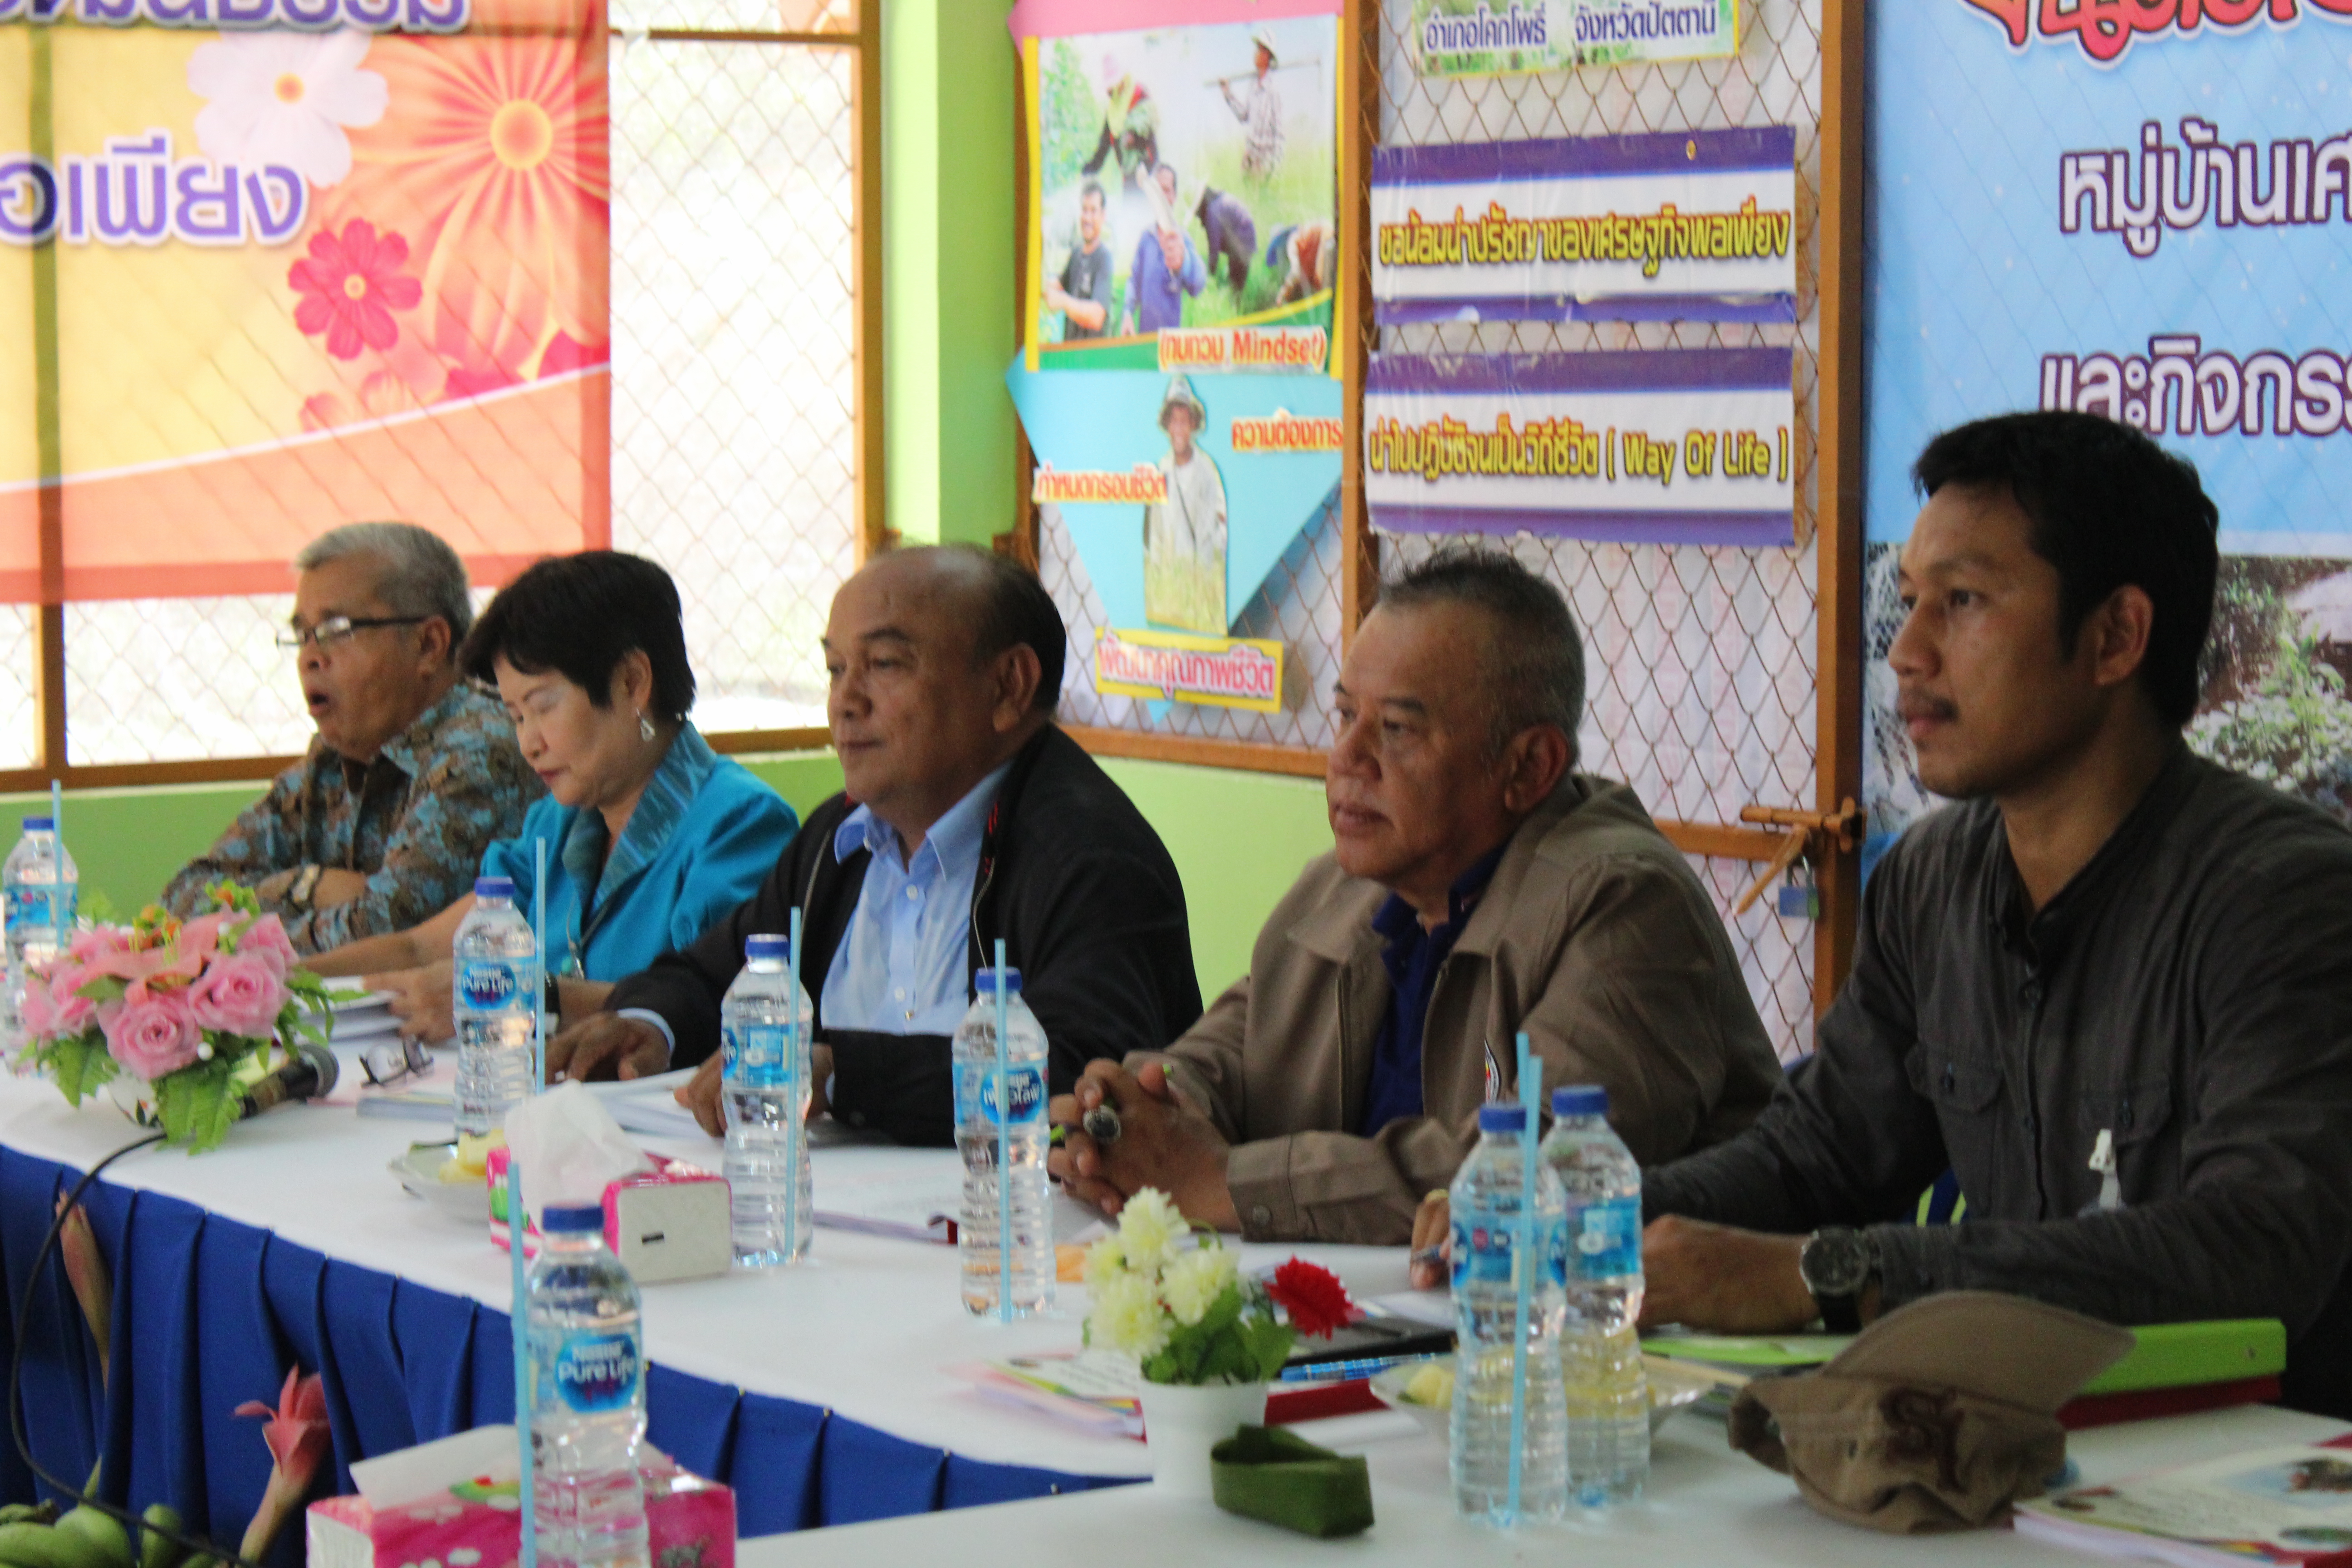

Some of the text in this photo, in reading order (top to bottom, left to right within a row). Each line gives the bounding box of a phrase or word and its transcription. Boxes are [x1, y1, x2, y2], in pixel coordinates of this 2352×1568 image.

[1379, 193, 1791, 278] ขอน้อมนำปรัชญาของเศรษฐกิจพอเพียง
[2040, 335, 2352, 437] และกิจกร
[1622, 430, 1677, 487] Way
[1684, 429, 1716, 476] Of
[1723, 430, 1771, 477] Life
[1096, 633, 1274, 693] พัฒนาคุณภาพชีวิต
